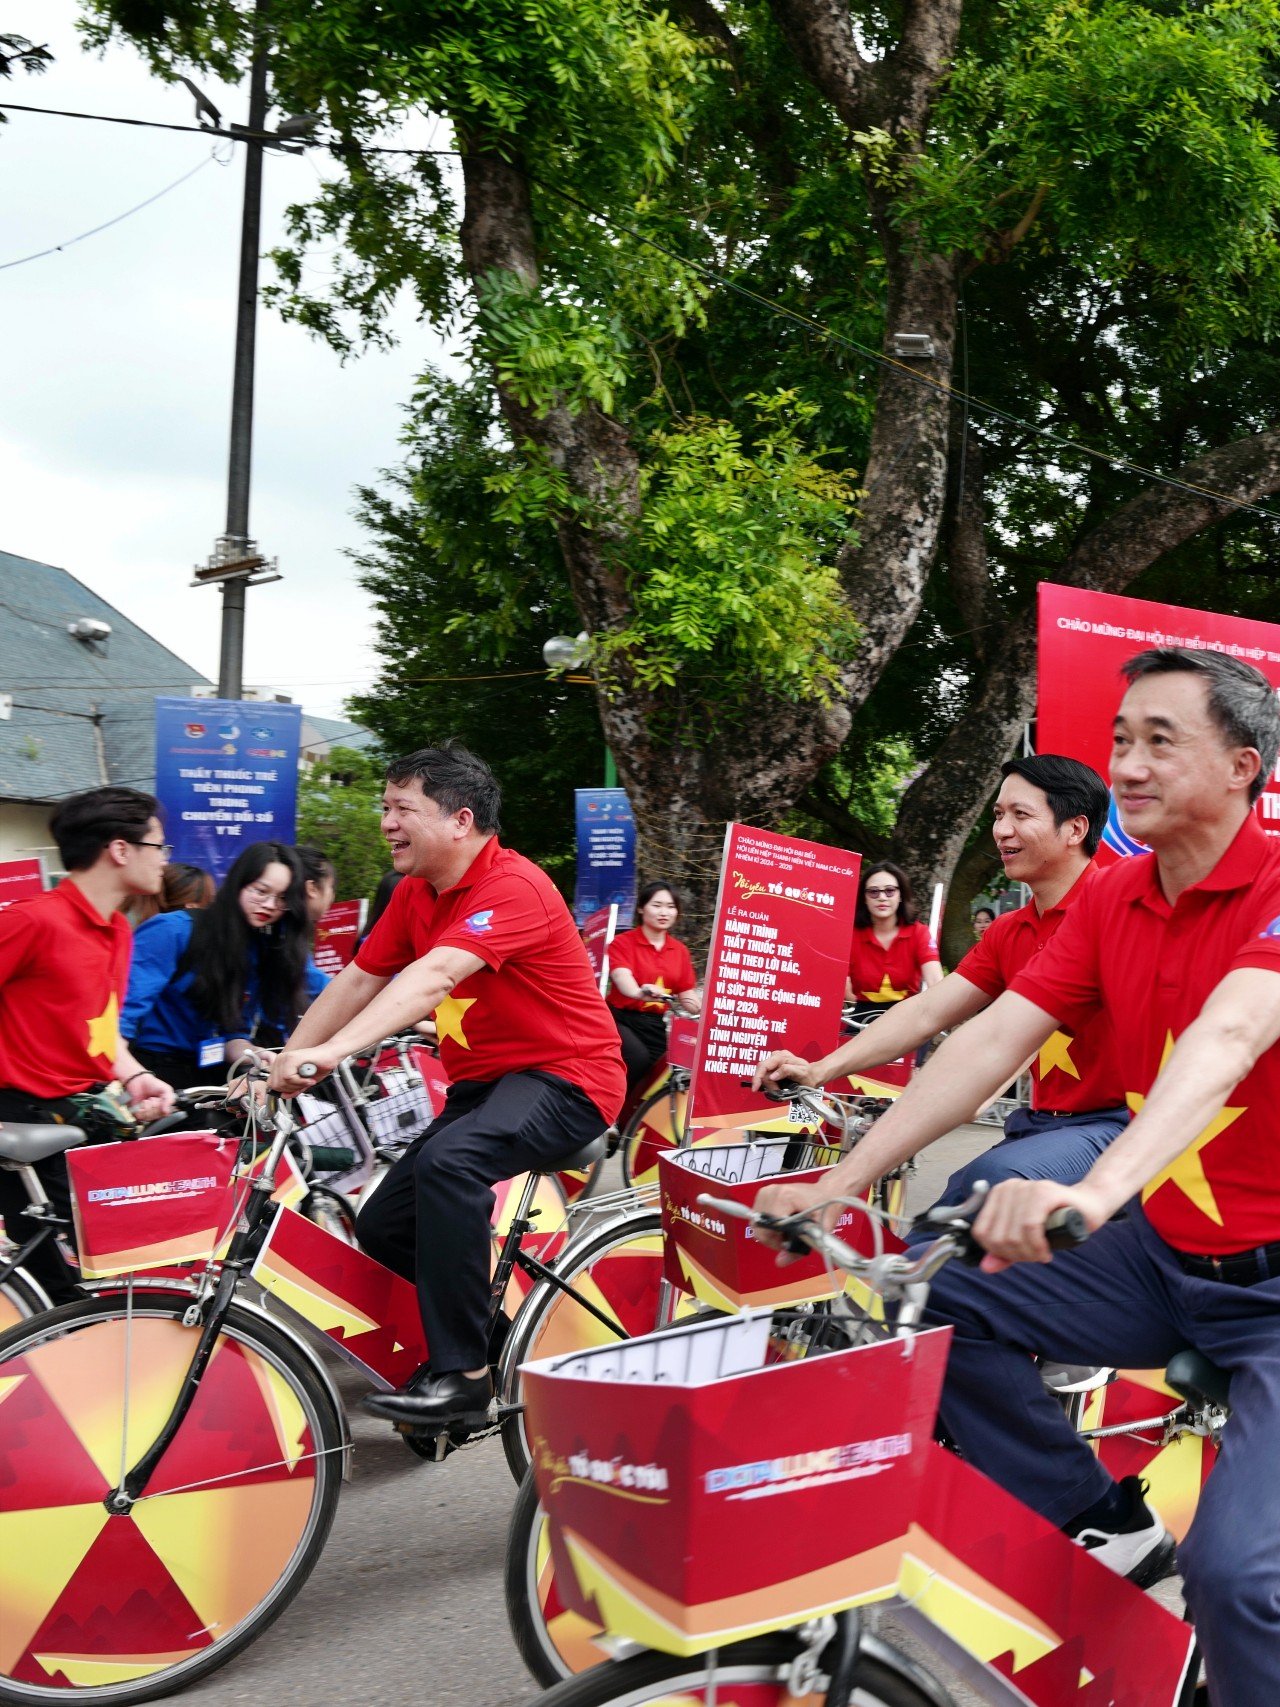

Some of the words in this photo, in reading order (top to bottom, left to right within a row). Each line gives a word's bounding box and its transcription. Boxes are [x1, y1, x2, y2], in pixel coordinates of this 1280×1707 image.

[1057, 617, 1091, 633] CHÀO
[768, 881, 783, 895] TỔ
[784, 887, 815, 902] QUỐC
[816, 892, 835, 906] TÔI
[738, 909, 748, 918] RA
[749, 911, 770, 922] QUÂN
[725, 919, 750, 933] HÀNH
[752, 924, 778, 939] TRÌNH
[747, 939, 775, 954] THUỐC
[777, 943, 793, 958] TRẺ
[720, 951, 741, 965] LÀM
[742, 954, 764, 968] THEO
[765, 955, 780, 971] LỜI
[780, 959, 801, 976] BÁC,
[718, 966, 739, 979] TÌNH
[740, 970, 776, 986] NGUYỆN
[716, 980, 725, 994] VÌ
[727, 982, 745, 997] SỨC
[771, 989, 797, 1005] CỘNG
[714, 996, 734, 1011] NĂM
[736, 1000, 759, 1015] 2024
[740, 1015, 768, 1031] THUỐC
[771, 1019, 787, 1034] TRẺ
[709, 1028, 731, 1042] TÌNH
[731, 1032, 767, 1048] NGUYỆN
[707, 1044, 717, 1057] VÌ
[718, 1045, 738, 1060] MỘT
[739, 1048, 758, 1062] VIỆT
[759, 1050, 773, 1063] NA
[705, 1059, 728, 1073] KHỎE
